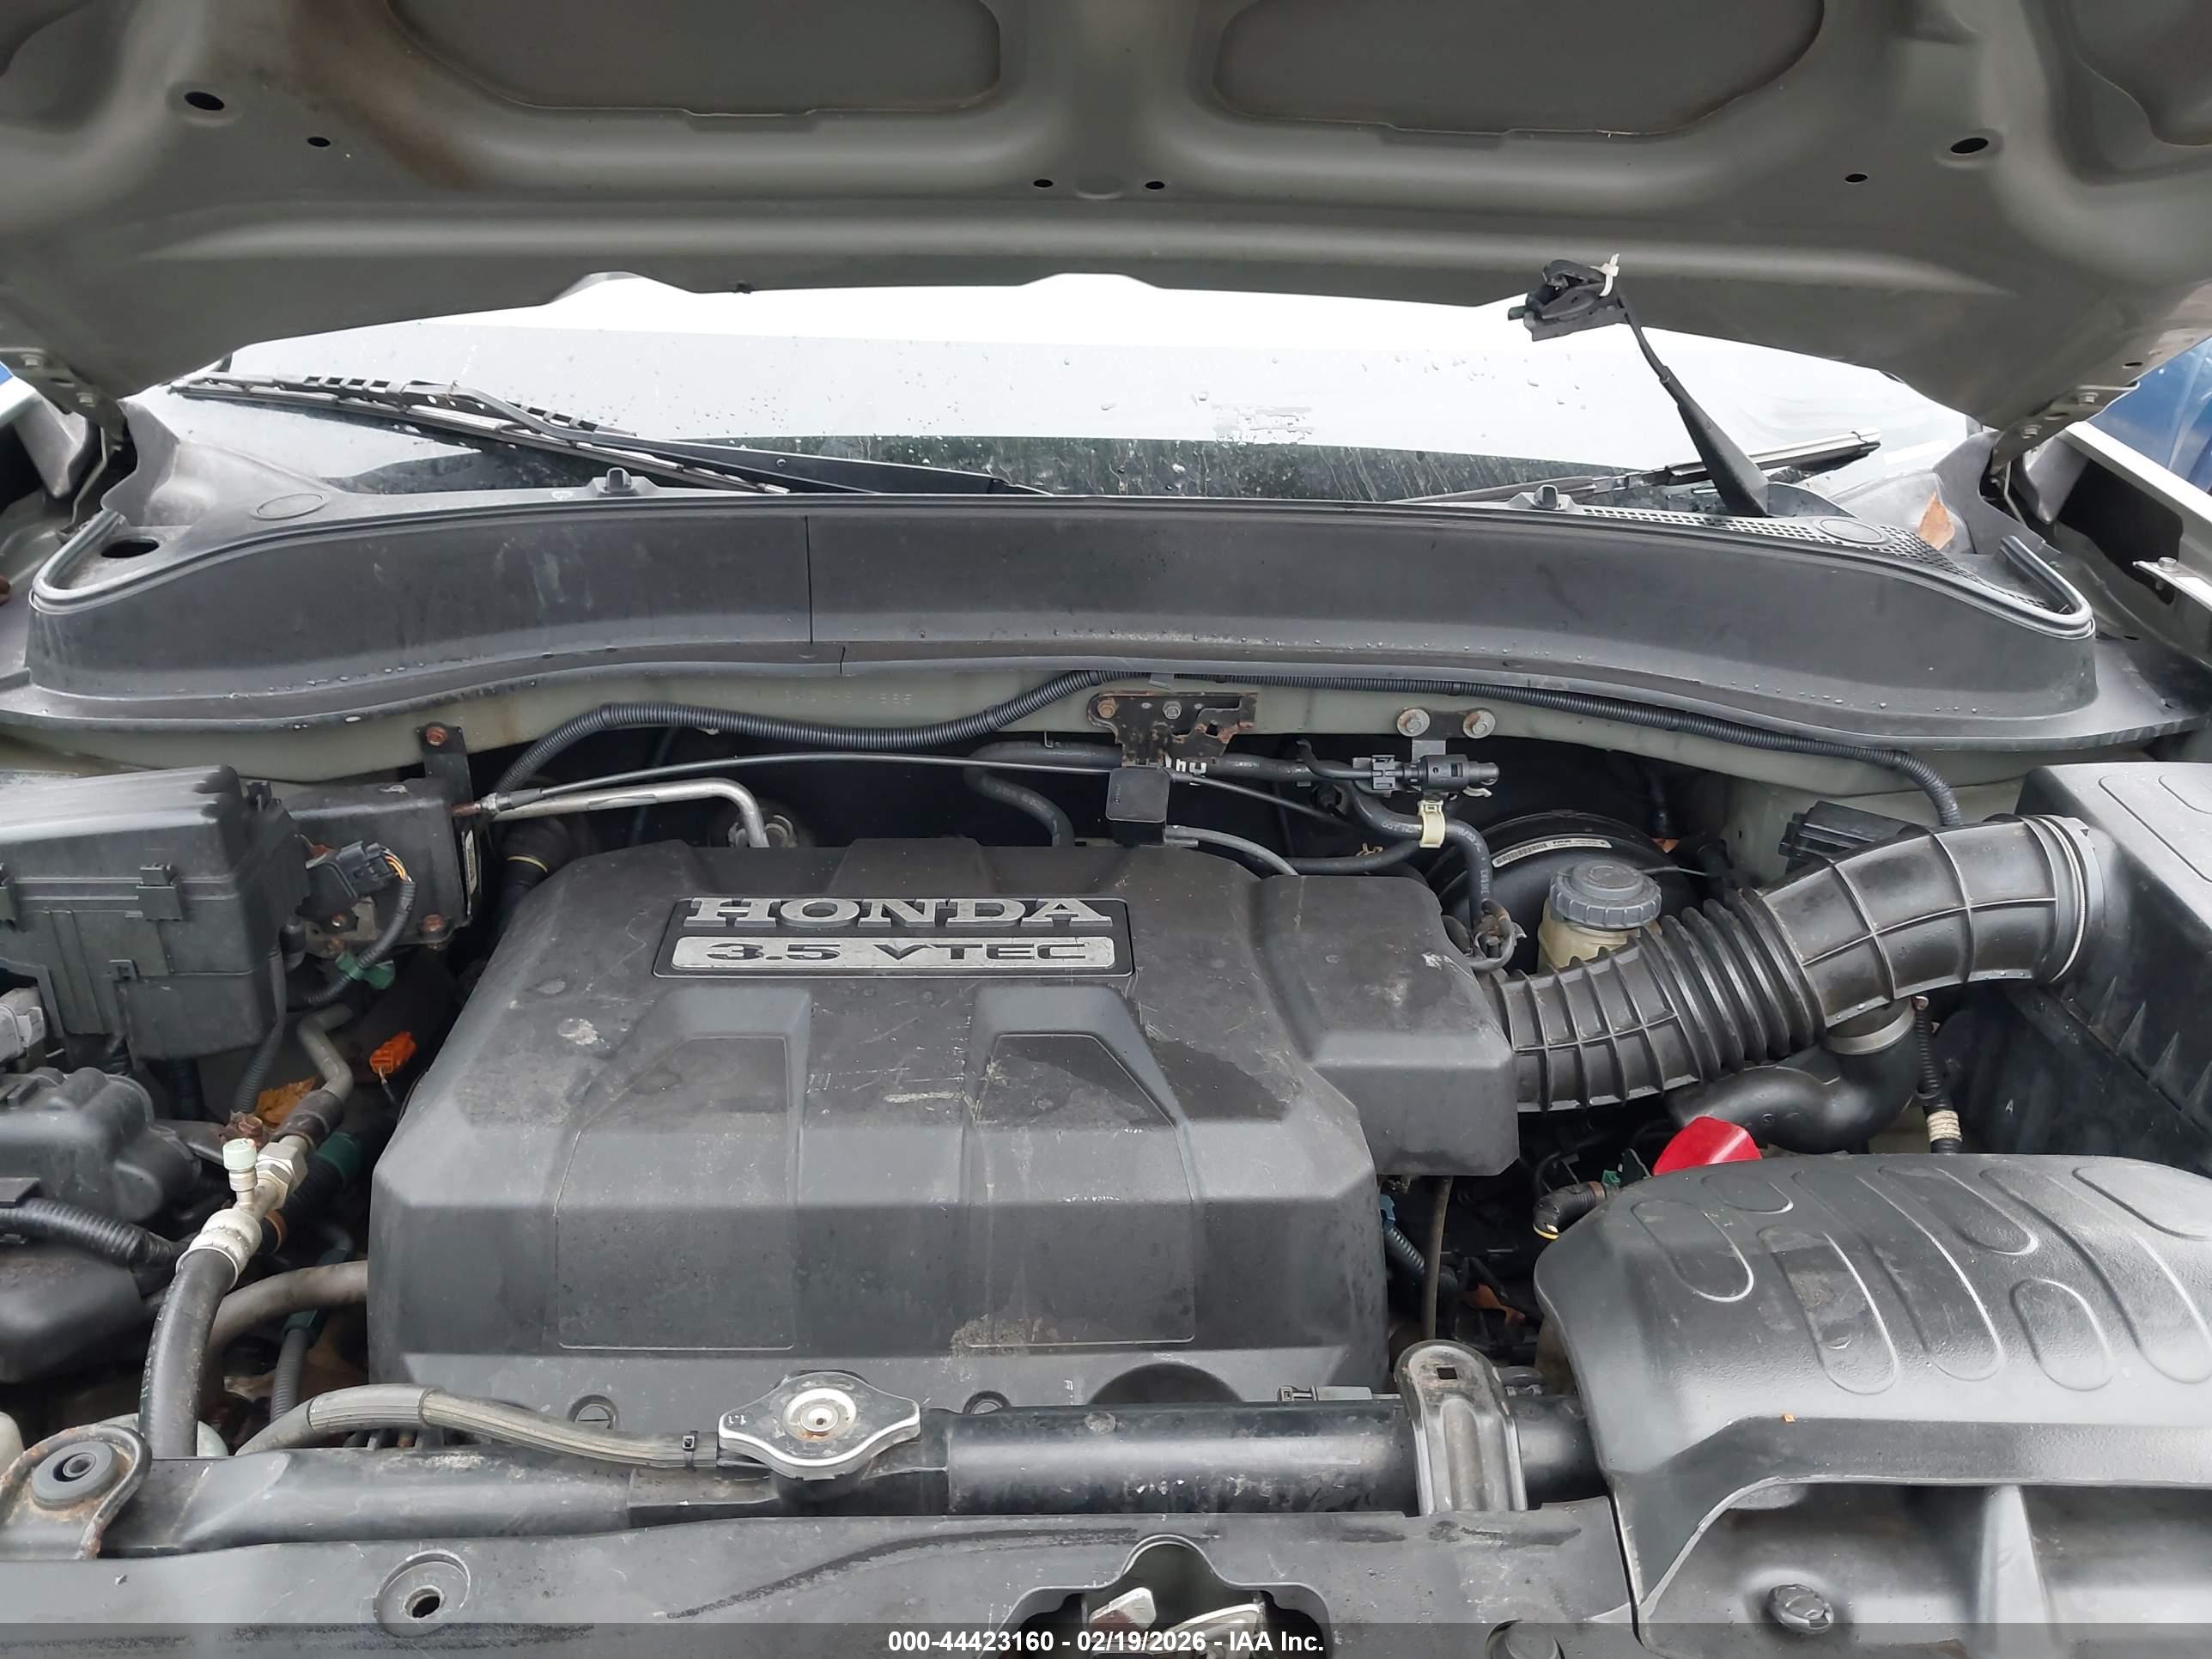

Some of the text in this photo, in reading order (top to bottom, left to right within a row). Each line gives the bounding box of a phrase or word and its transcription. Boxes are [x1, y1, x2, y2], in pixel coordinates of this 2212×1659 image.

[684, 898, 1113, 928] HONDA
[707, 942, 1091, 961] 3.5 VTEC
